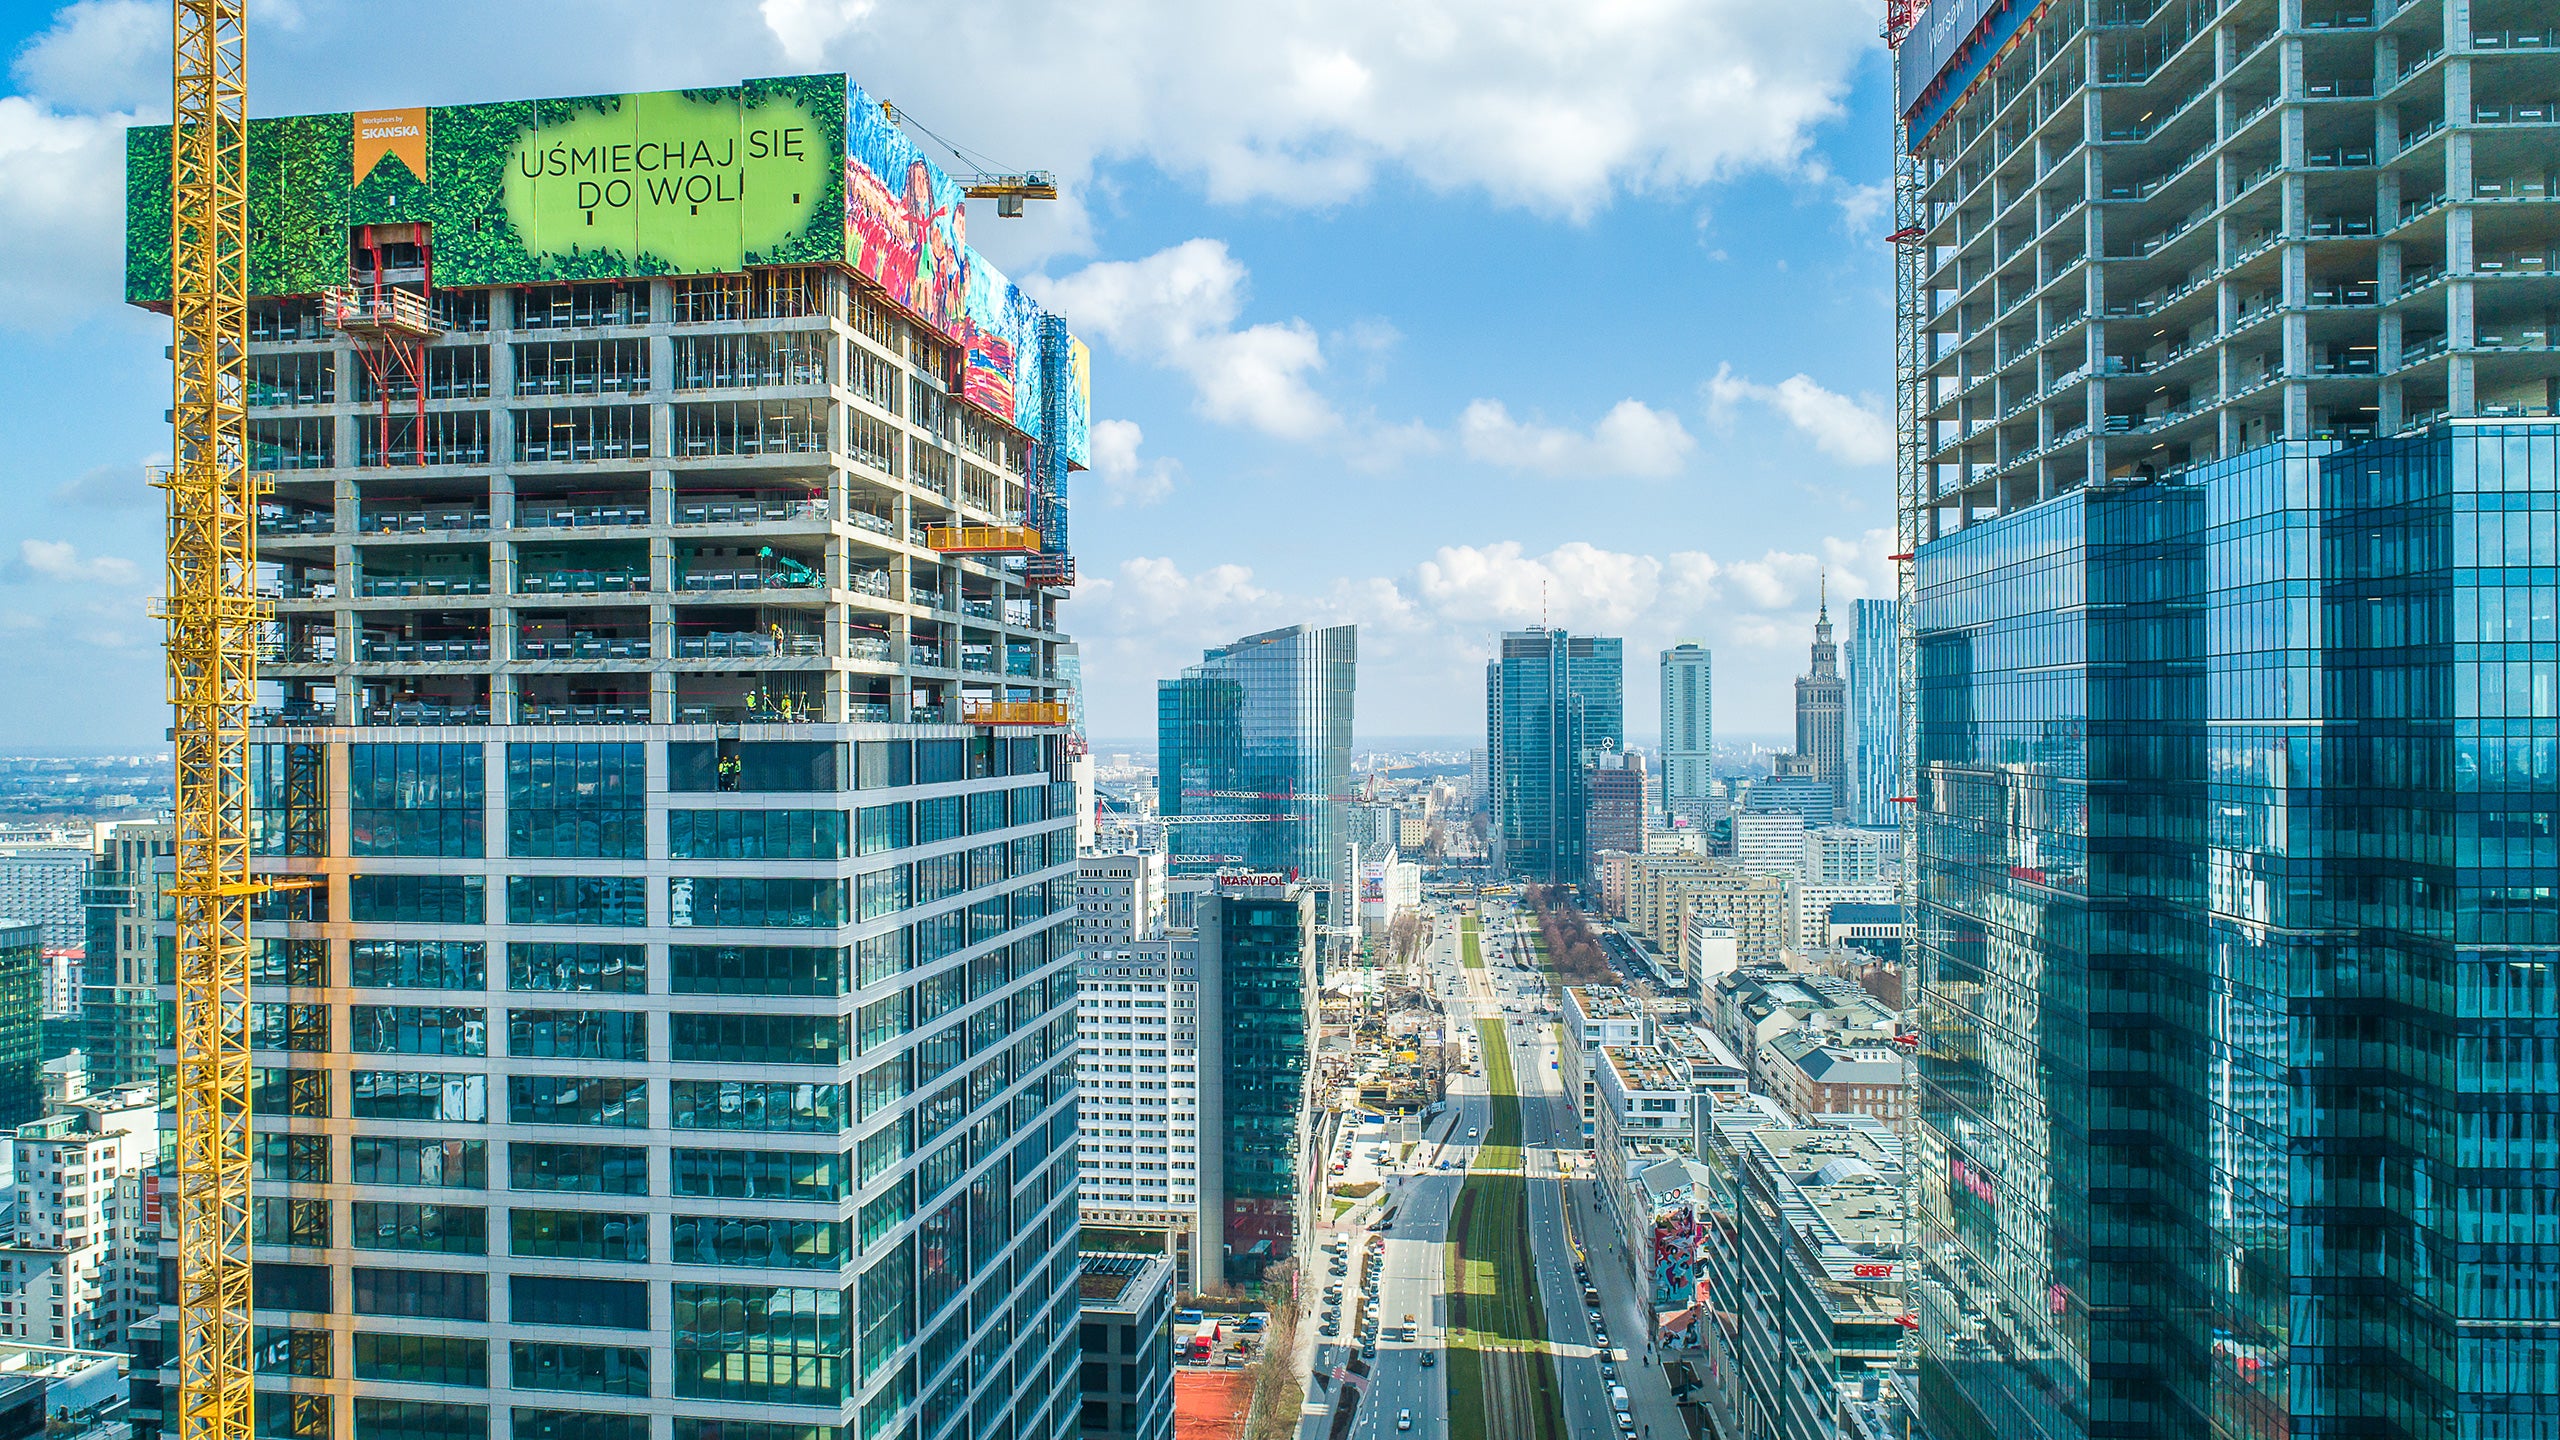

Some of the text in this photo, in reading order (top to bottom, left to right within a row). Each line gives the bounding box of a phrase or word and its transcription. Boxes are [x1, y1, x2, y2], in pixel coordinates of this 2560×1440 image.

[1928, 0, 1965, 53] Warsaw
[361, 126, 420, 140] SKANSKA
[521, 127, 805, 178] UŚMIECHAJ SIĘ
[578, 167, 744, 210] DO WOLI
[1220, 875, 1287, 886] MARVIPOL
[1853, 1264, 1894, 1278] GREY
